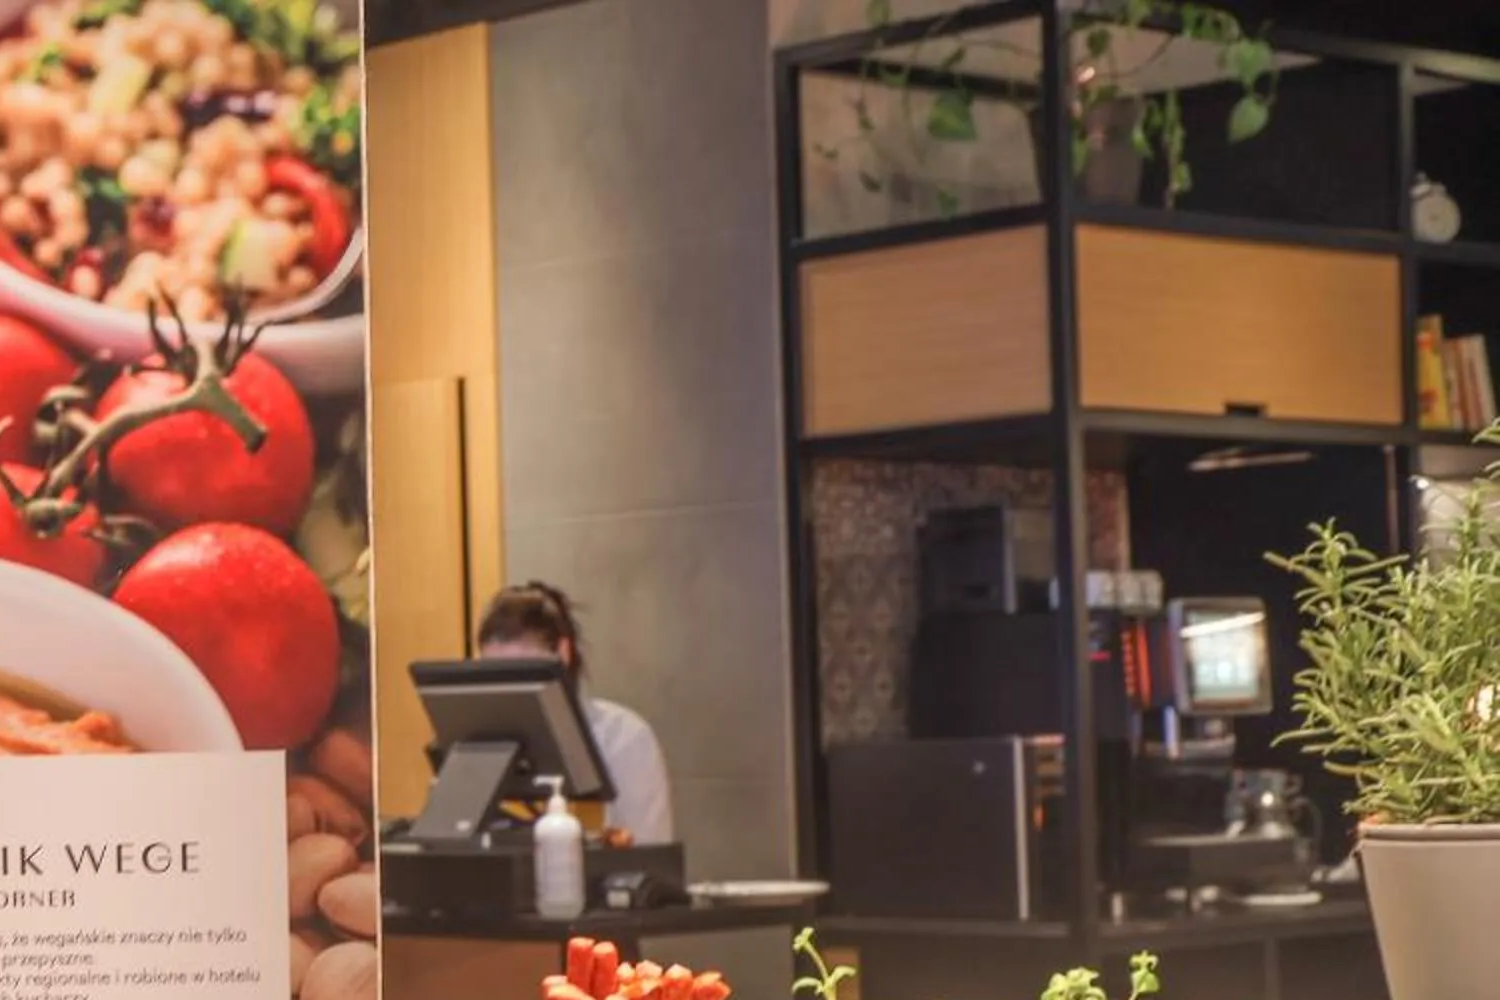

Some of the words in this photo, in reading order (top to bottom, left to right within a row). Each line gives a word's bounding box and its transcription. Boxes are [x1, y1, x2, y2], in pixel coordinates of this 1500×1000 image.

[65, 841, 200, 875] WEGE
[35, 928, 115, 948] wegańskie
[120, 931, 175, 945] znaczy
[178, 927, 203, 942] nie
[207, 926, 248, 944] tylko
[25, 970, 111, 989] regionalne
[124, 967, 188, 984] robione
[208, 966, 261, 984] hotelu
